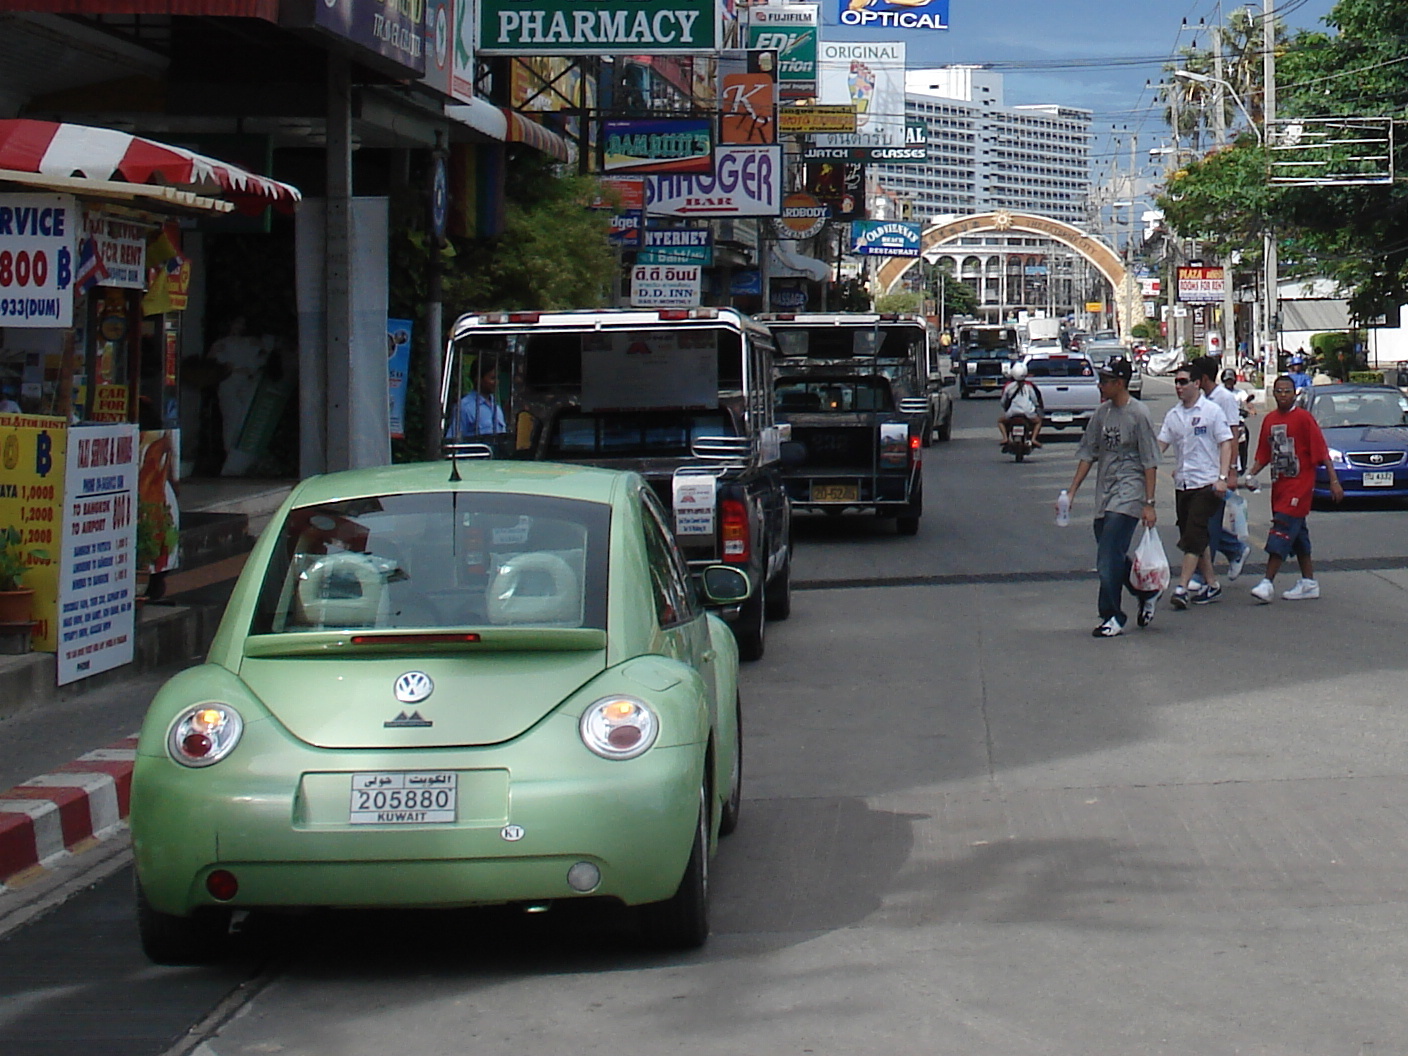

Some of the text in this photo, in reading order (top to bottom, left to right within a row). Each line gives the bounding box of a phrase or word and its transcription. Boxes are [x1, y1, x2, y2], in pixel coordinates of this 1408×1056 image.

[768, 12, 812, 21] FUJIFILM
[840, 10, 947, 29] OPTICAL
[497, 10, 700, 43] PHARMACY
[825, 45, 898, 59] ORIGINAL
[804, 149, 849, 158] WATCH
[871, 149, 925, 158] GLASSES
[685, 197, 733, 206] BAR
[121, 244, 142, 265] RENT
[868, 247, 919, 256] RESTAURANT
[1179, 269, 1203, 279] PLAZA
[669, 289, 693, 298] INN
[99, 388, 125, 399] CAR
[100, 400, 124, 411] FOR
[82, 518, 106, 534] AIRPORT
[358, 790, 448, 809] 205880
[377, 812, 427, 822] KUWAIT
